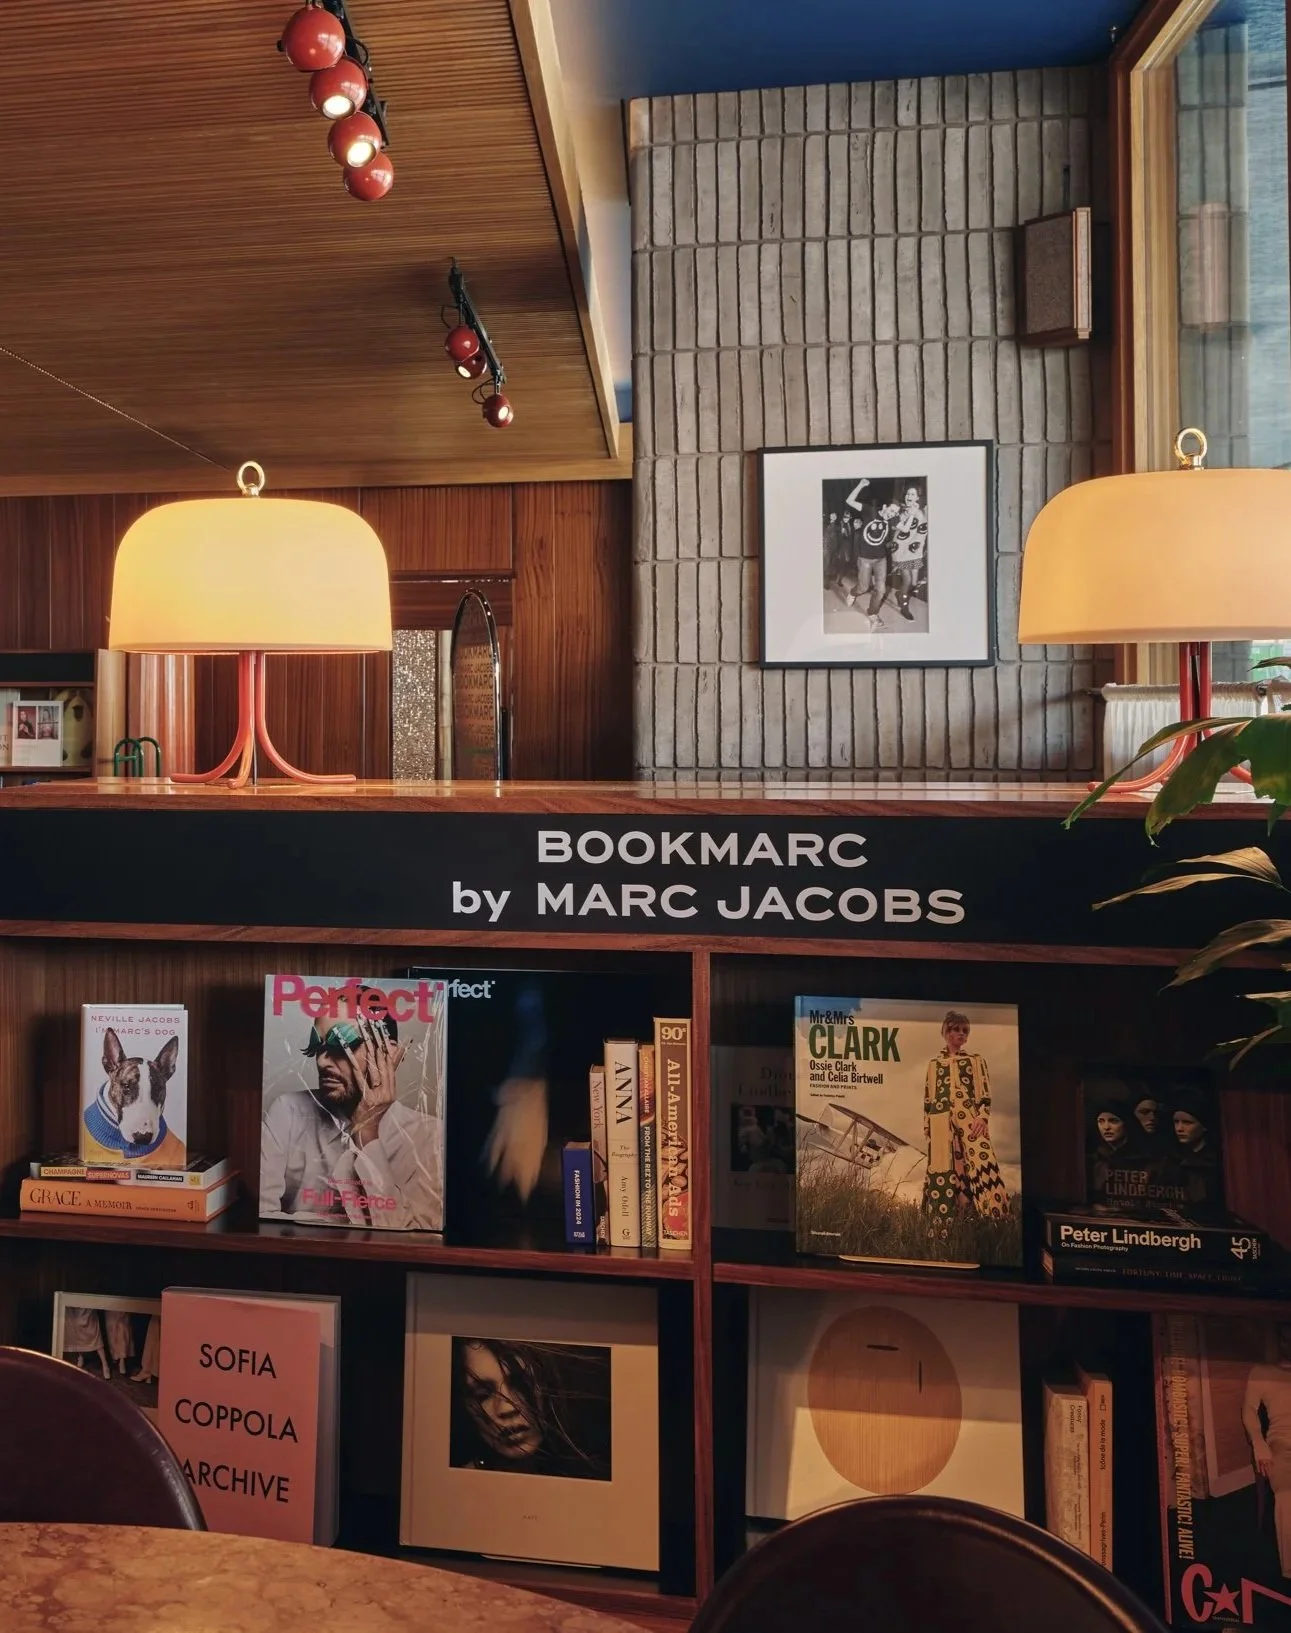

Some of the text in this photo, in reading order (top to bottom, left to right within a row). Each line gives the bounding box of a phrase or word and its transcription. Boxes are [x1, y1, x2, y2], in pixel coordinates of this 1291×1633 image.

[537, 830, 868, 868] BOOKMARC
[452, 881, 965, 925] by MARC JACOBS
[273, 974, 434, 1023] Perfect
[447, 978, 492, 999] rfect
[91, 1015, 180, 1024] NEVILLE JACOBS
[112, 1027, 151, 1035] MARC'S
[154, 1028, 176, 1036] DOG
[809, 1009, 855, 1025] Mr&Mrs
[808, 1024, 901, 1062] CLARK
[809, 1060, 857, 1072] Ossie Clark
[809, 1071, 884, 1085] and Celia Birtwell
[592, 1080, 604, 1129] New York
[614, 1060, 633, 1124] ANNA
[667, 1058, 682, 1178] All-American
[573, 1169, 581, 1199] FASHION
[645, 1178, 652, 1189] TO
[1105, 1168, 1149, 1184] PETER
[1106, 1183, 1185, 1199] LINDBERGH
[29, 1188, 82, 1207] GRACE
[85, 1200, 92, 1208] A
[92, 1200, 132, 1210] MEMOIR
[575, 1199, 582, 1207] IN
[645, 1189, 653, 1204] THE
[669, 1182, 682, 1217] Ads
[645, 1204, 653, 1236] RUNWAY
[1060, 1225, 1201, 1252] Peter Lindbergh
[1093, 1244, 1129, 1252] Photography
[199, 1343, 276, 1379] SOFIA
[174, 1398, 299, 1443] COPPOLA
[1174, 1431, 1190, 1468] SUPER!
[181, 1458, 289, 1503] ARCHIVE
[1175, 1472, 1193, 1525] FANTASTIC!
[1178, 1528, 1194, 1560] ALIVE!
